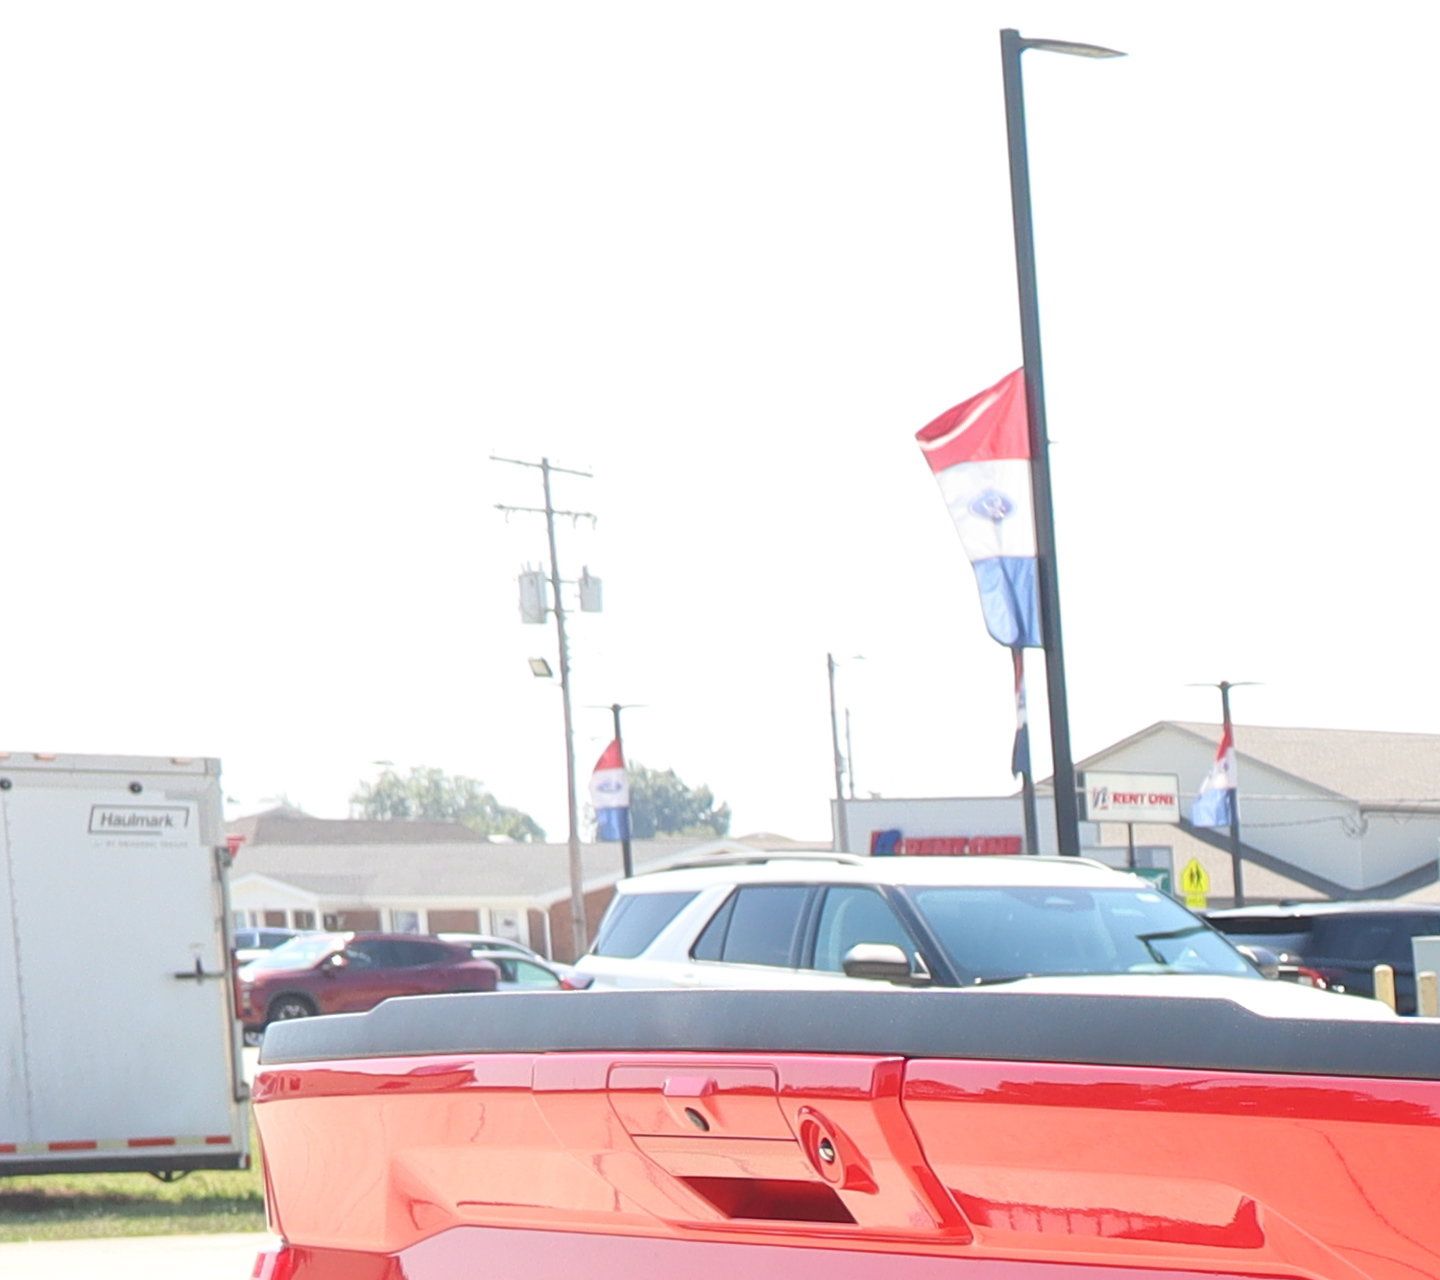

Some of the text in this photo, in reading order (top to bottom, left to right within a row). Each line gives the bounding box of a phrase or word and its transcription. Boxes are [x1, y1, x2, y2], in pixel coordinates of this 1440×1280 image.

[1113, 792, 1174, 805] RENT ONE
[101, 812, 173, 828] Haulmark
